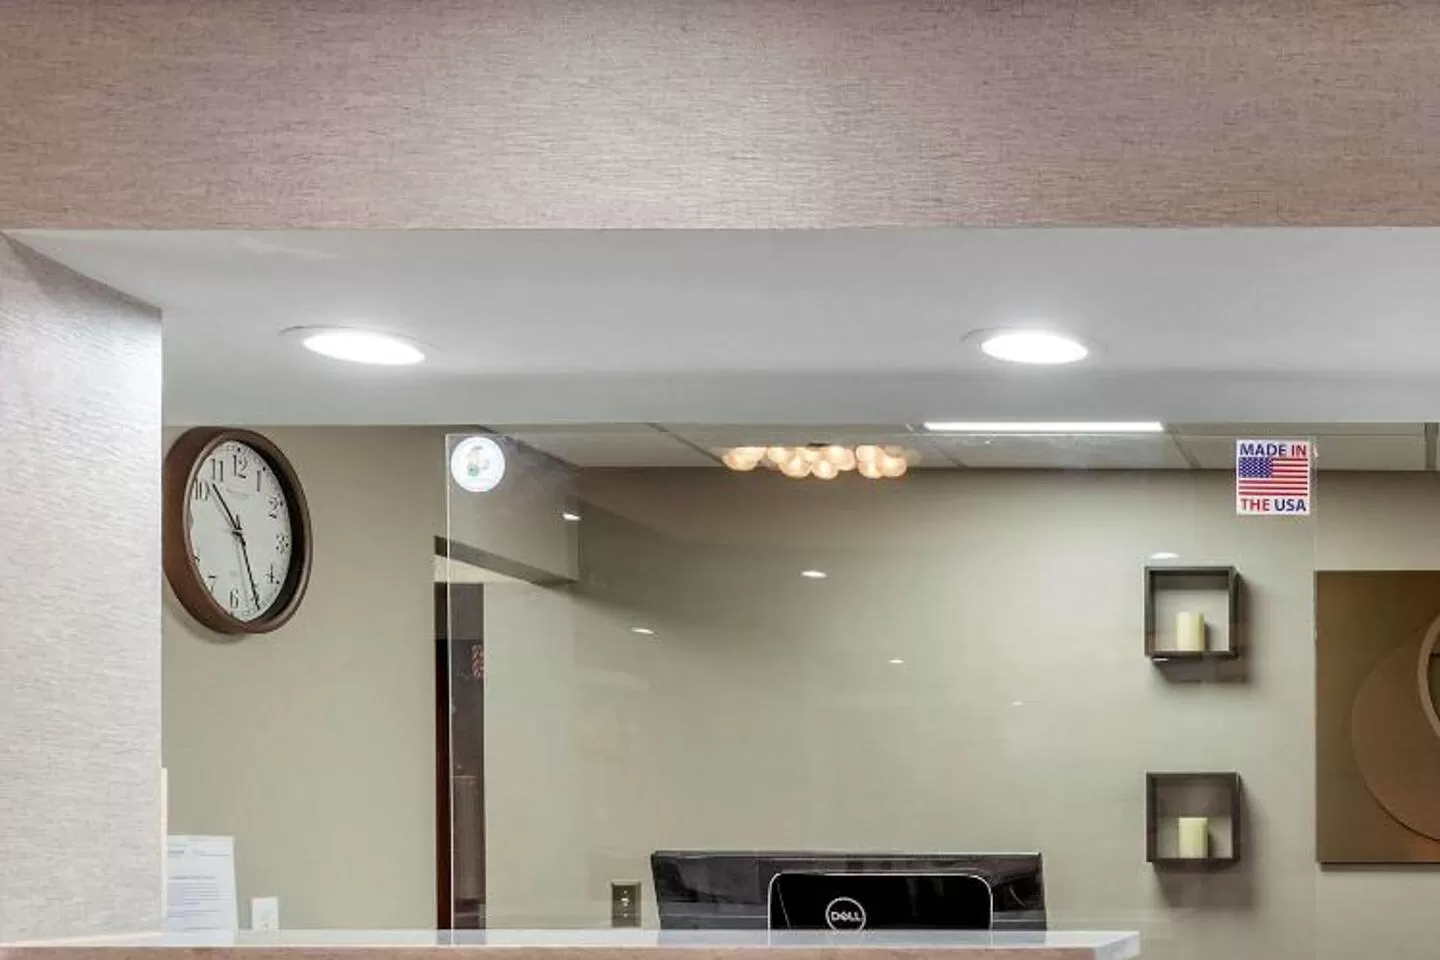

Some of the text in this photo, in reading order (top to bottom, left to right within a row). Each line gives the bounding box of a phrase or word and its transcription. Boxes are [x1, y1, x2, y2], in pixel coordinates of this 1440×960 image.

[1240, 443, 1307, 456] MADE IN
[211, 458, 224, 482] 11
[233, 454, 248, 479] 12
[268, 496, 278, 519] 2
[1240, 499, 1307, 512] THE USA
[831, 911, 862, 922] DELL
